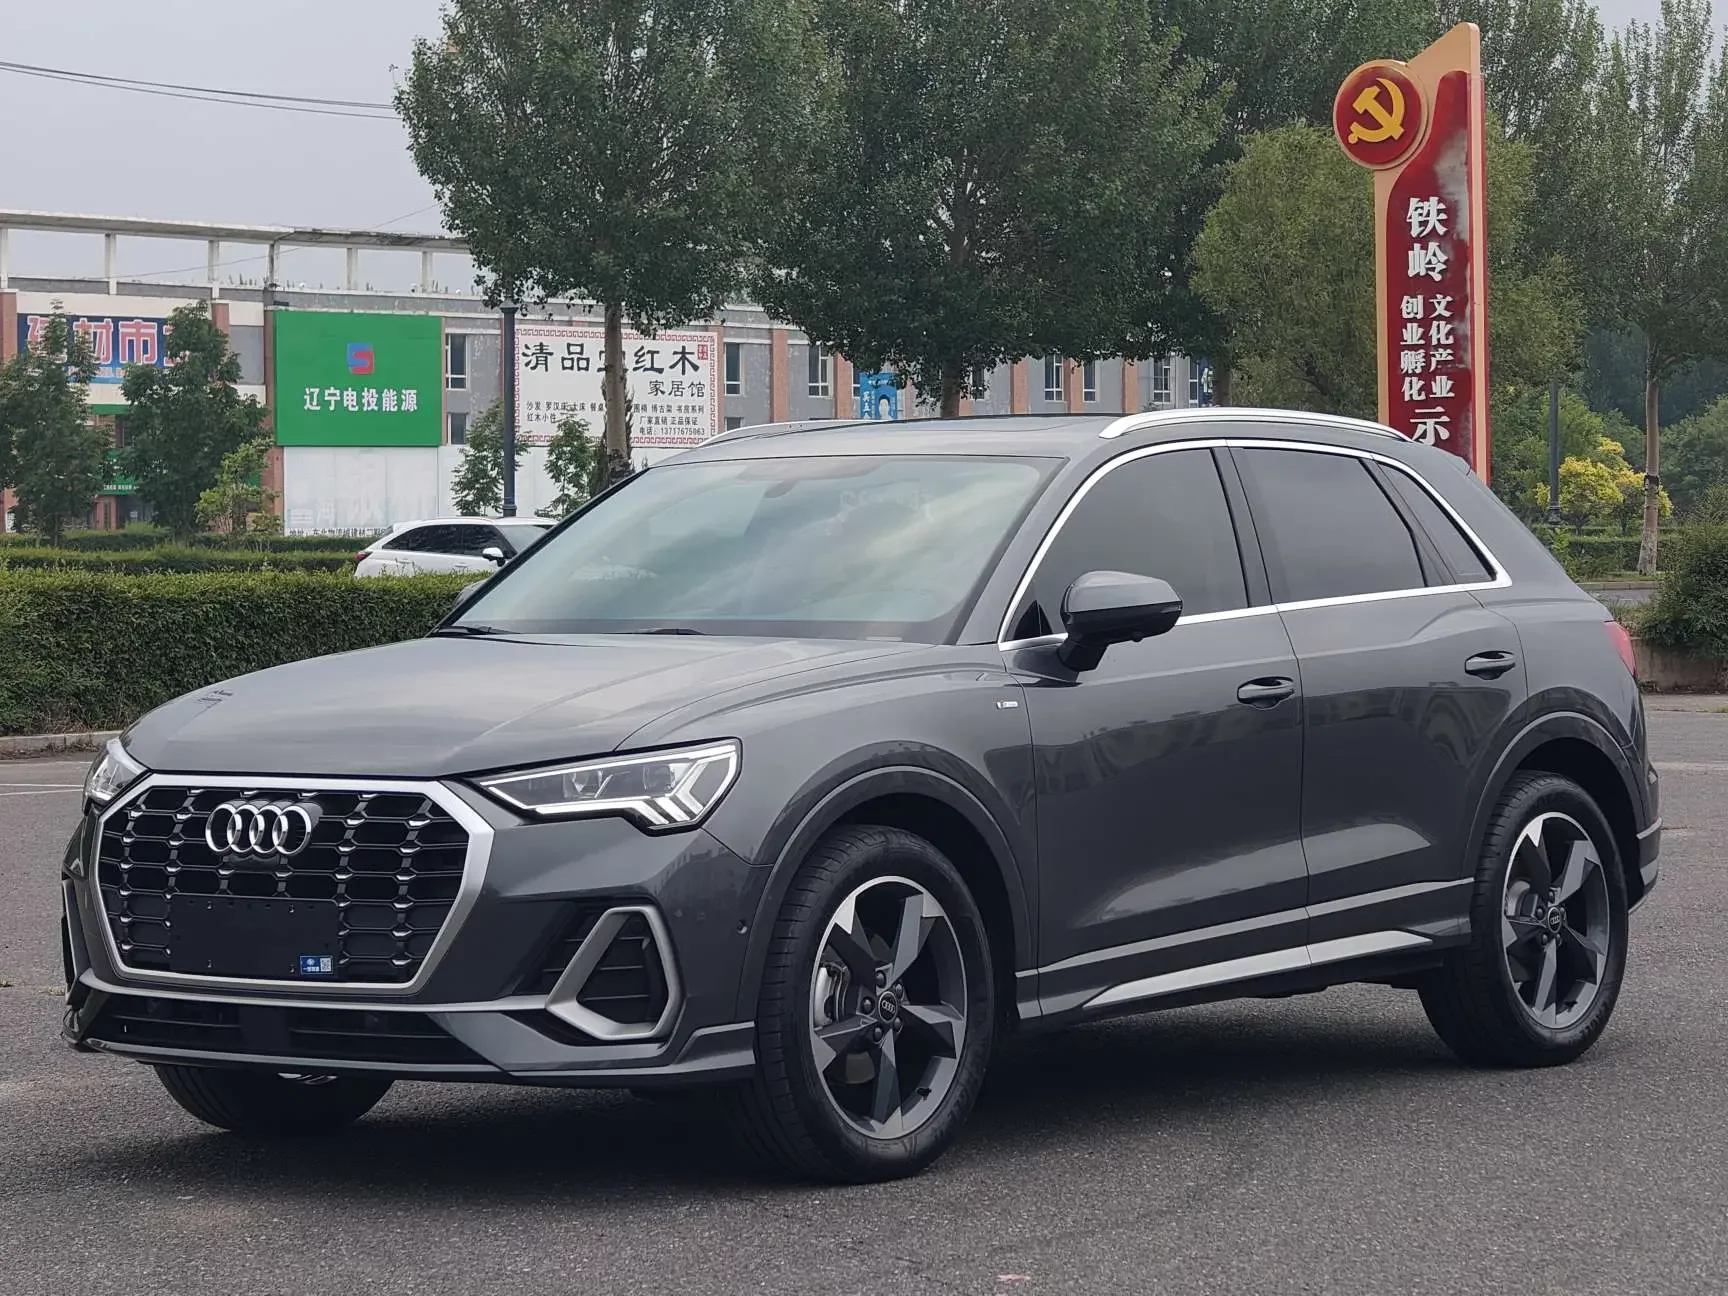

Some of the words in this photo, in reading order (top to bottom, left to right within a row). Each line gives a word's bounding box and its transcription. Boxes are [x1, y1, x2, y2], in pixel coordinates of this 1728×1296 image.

[1406, 196, 1448, 282] 铁岭
[1400, 294, 1426, 401] 创业孵化
[1428, 293, 1455, 398] 文化产业
[303, 386, 418, 412] 辽宁电投能源
[648, 380, 706, 398] 家居馆
[1409, 406, 1451, 446] 示
